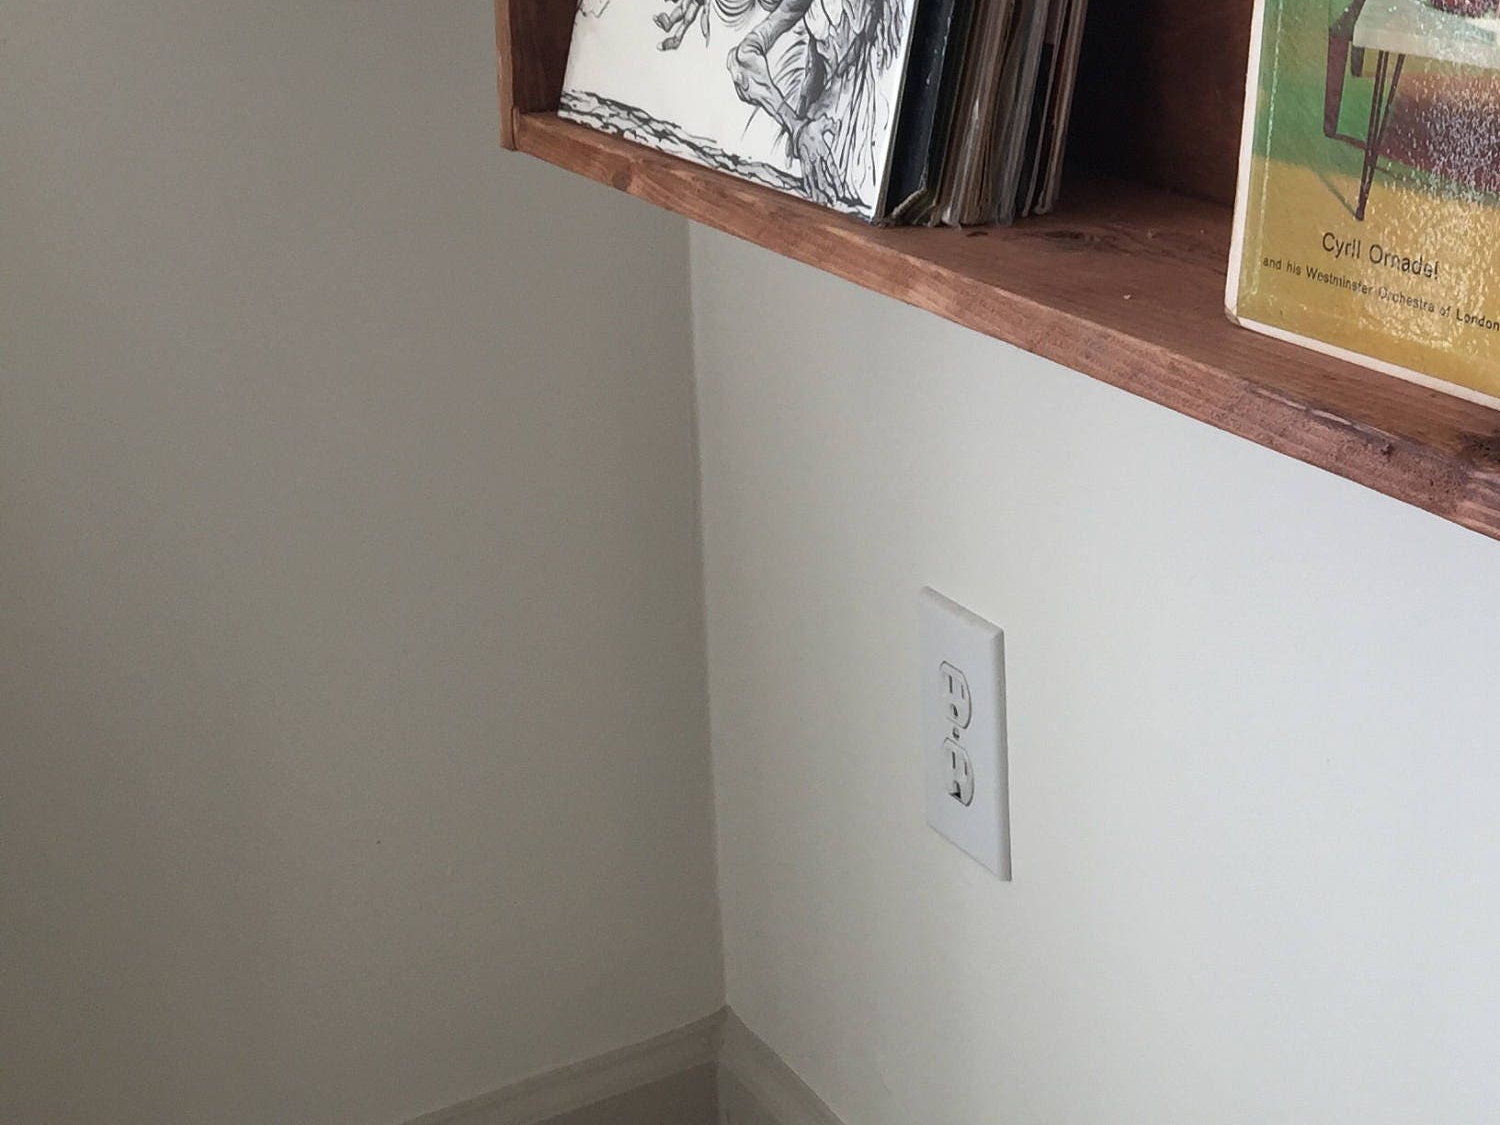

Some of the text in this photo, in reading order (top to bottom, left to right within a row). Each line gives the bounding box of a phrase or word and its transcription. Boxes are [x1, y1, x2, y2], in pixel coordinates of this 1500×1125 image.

[1322, 232, 1361, 259] Cyril
[1262, 255, 1500, 332] and his Westminster Orchestra of London
